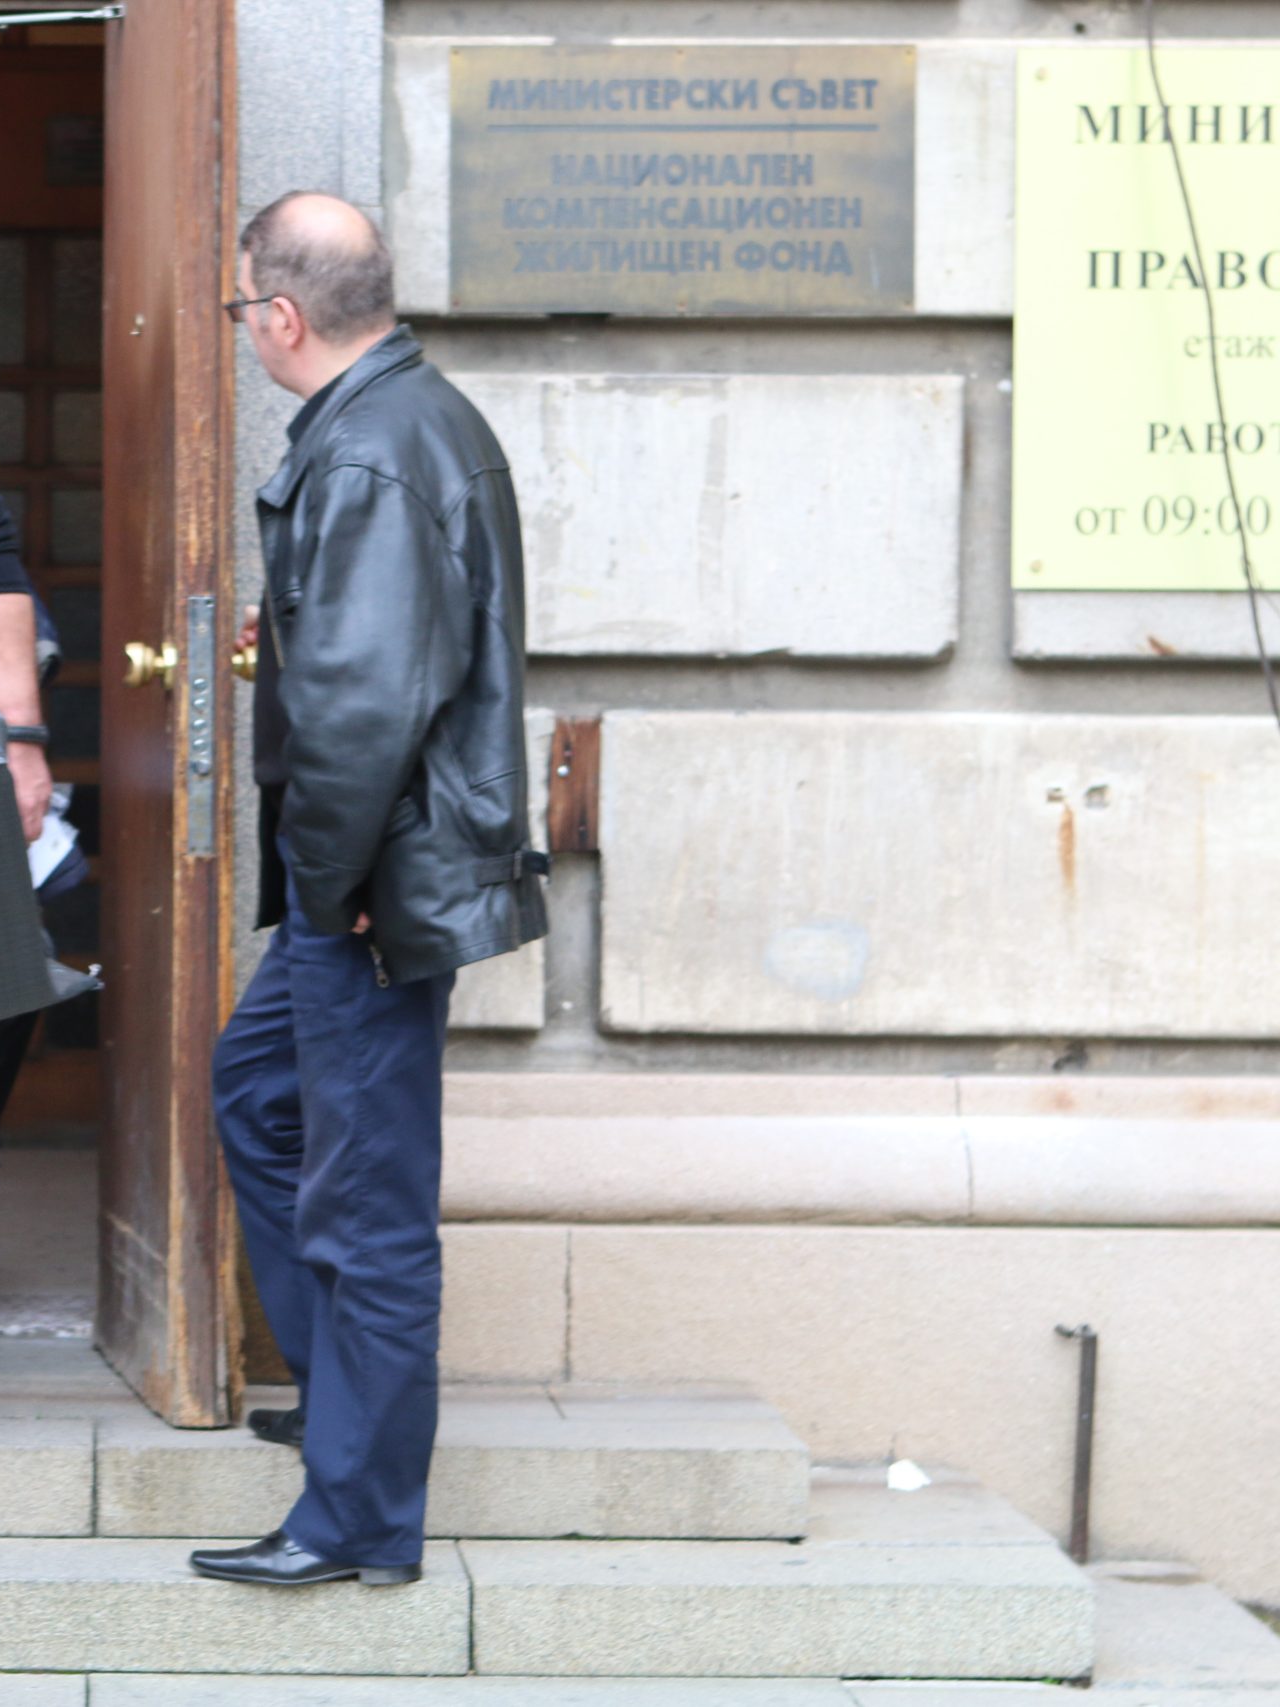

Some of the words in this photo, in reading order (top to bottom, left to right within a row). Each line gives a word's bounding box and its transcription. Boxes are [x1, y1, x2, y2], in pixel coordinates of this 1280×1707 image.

[487, 78, 759, 111] МИНИСТЕРСКИ
[770, 78, 878, 111] СЪВЕТ
[1074, 104, 1277, 143] МИНИ
[551, 154, 814, 188] НАЦИОНАЛЕН
[503, 197, 862, 233] КОМПЕНСАЦИОНЕН
[513, 241, 721, 276] ЖИЛИЩЕН
[733, 240, 854, 277] ФОНД
[1074, 506, 1125, 535] от
[1143, 495, 1271, 536] 09:00
